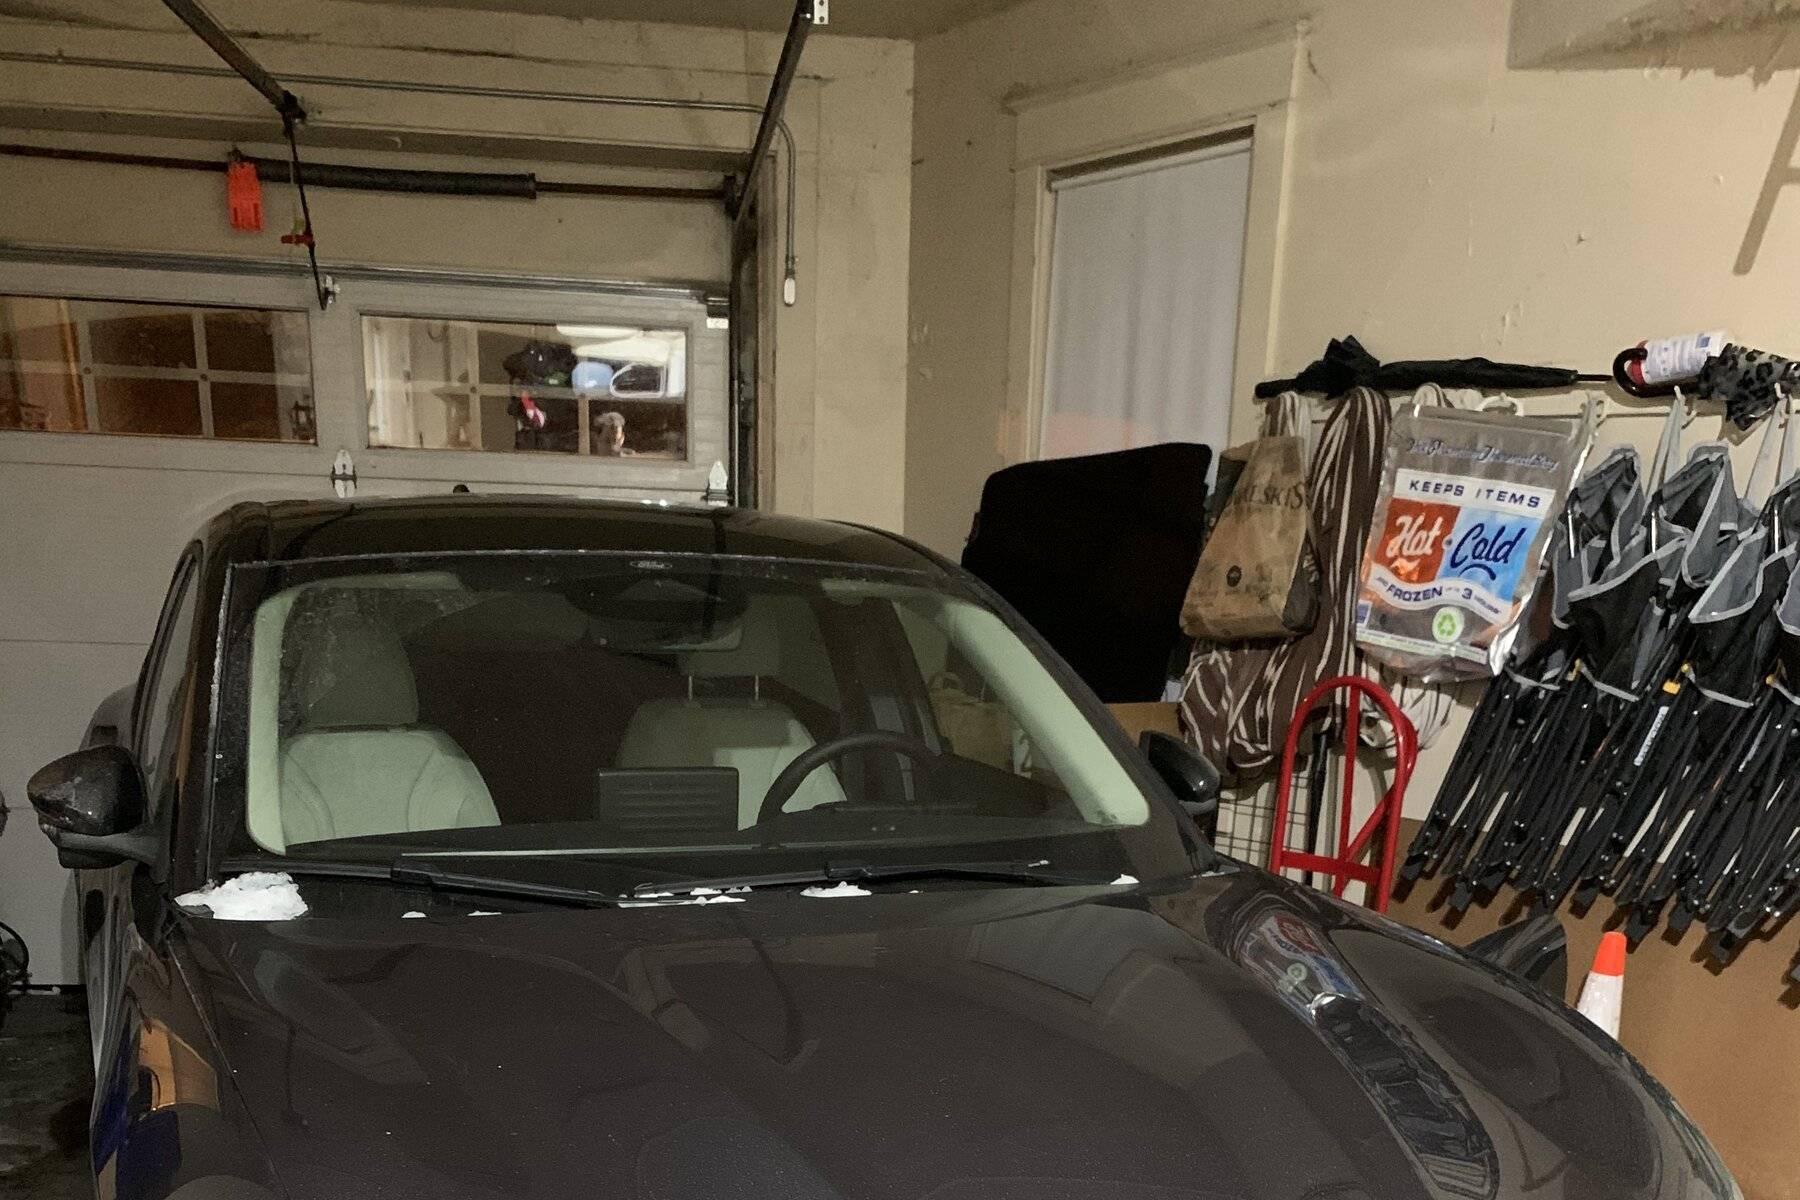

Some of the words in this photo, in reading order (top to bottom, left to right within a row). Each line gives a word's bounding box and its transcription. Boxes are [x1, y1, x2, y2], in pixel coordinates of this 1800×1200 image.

[1409, 478, 1465, 497] KEEPS
[1475, 486, 1541, 509] ITEMS
[1385, 514, 1444, 559] Hot
[1449, 522, 1527, 569] Cold
[1386, 583, 1443, 602] FROZEN
[1461, 587, 1473, 600] 3
